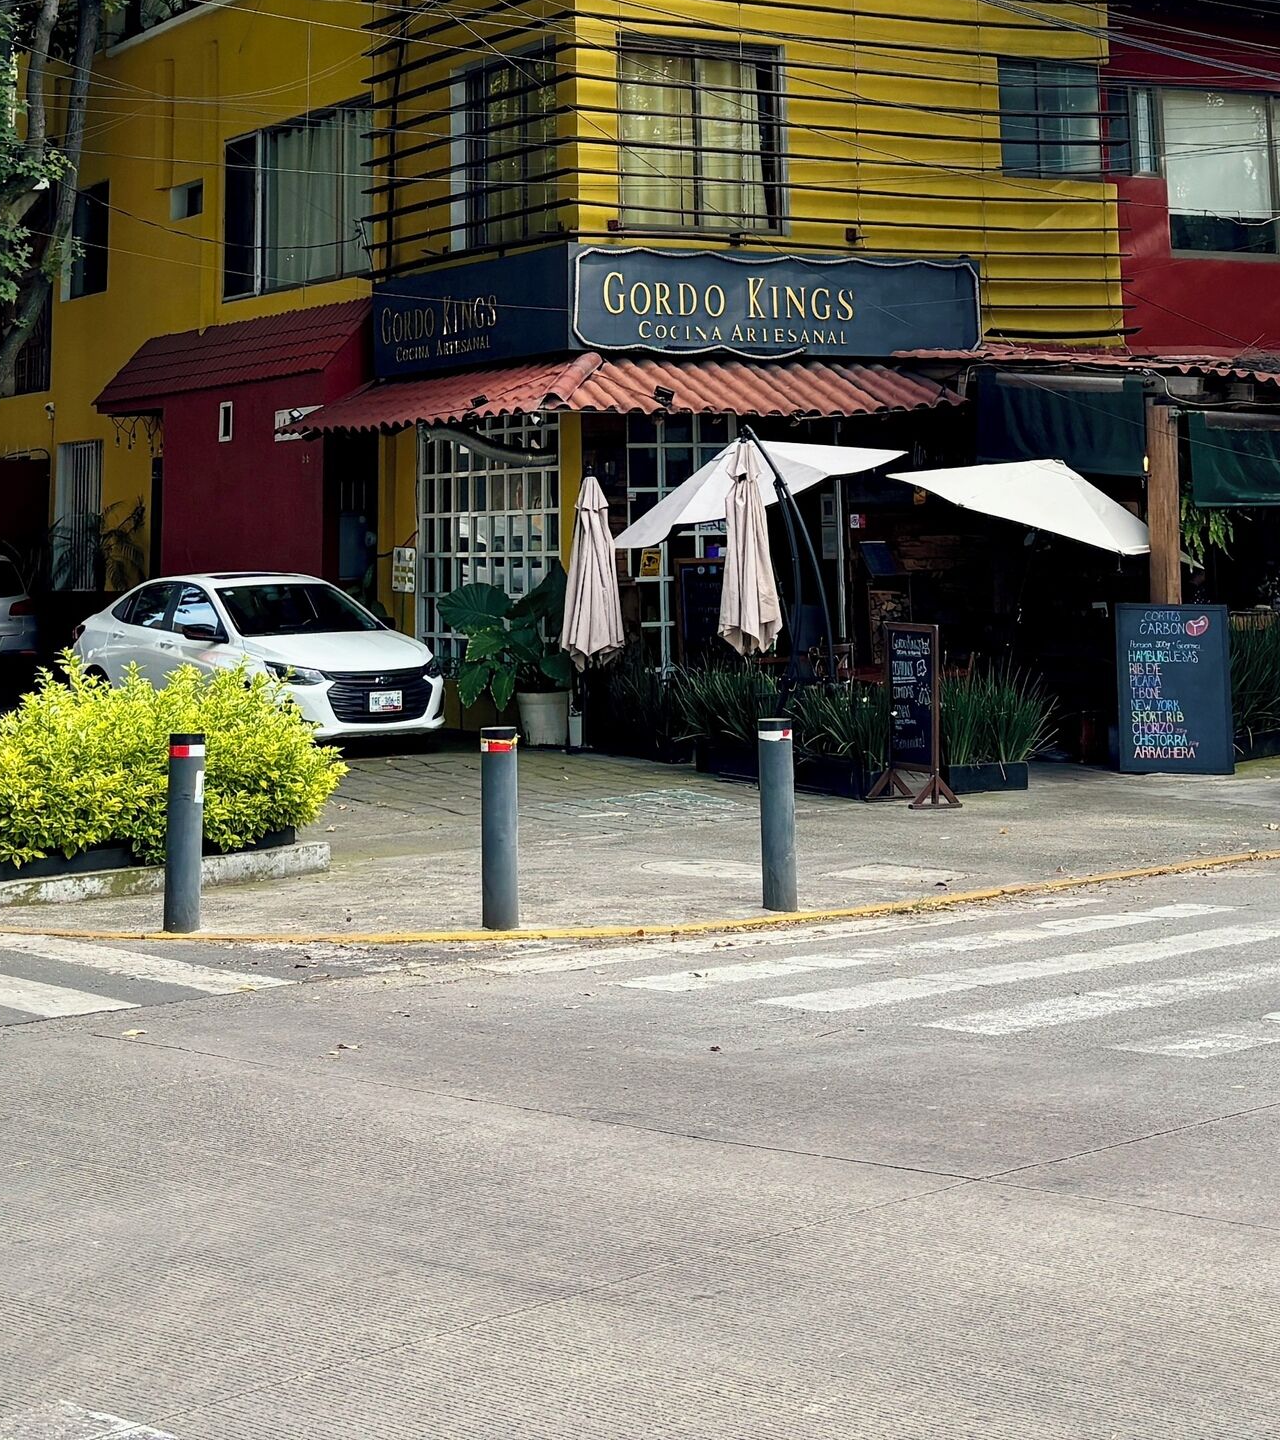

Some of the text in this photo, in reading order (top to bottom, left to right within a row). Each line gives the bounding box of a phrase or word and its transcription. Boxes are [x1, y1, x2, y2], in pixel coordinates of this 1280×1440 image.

[603, 271, 855, 321] GORDO KINGS
[381, 295, 497, 345] GORDO KINGS
[638, 320, 849, 345] COCINA ARTESANAL
[395, 335, 491, 362] COCINA ARTESANAL
[1128, 650, 1199, 664] HAMBURGUESAS
[1129, 663, 1144, 675] RIB
[1131, 700, 1180, 711] NEW YORK
[1131, 711, 1184, 722] SHORT RIB
[1132, 722, 1174, 734] CHORIZO
[1133, 734, 1188, 746] CHISTORRA
[1134, 747, 1195, 759] ARRACHERA
